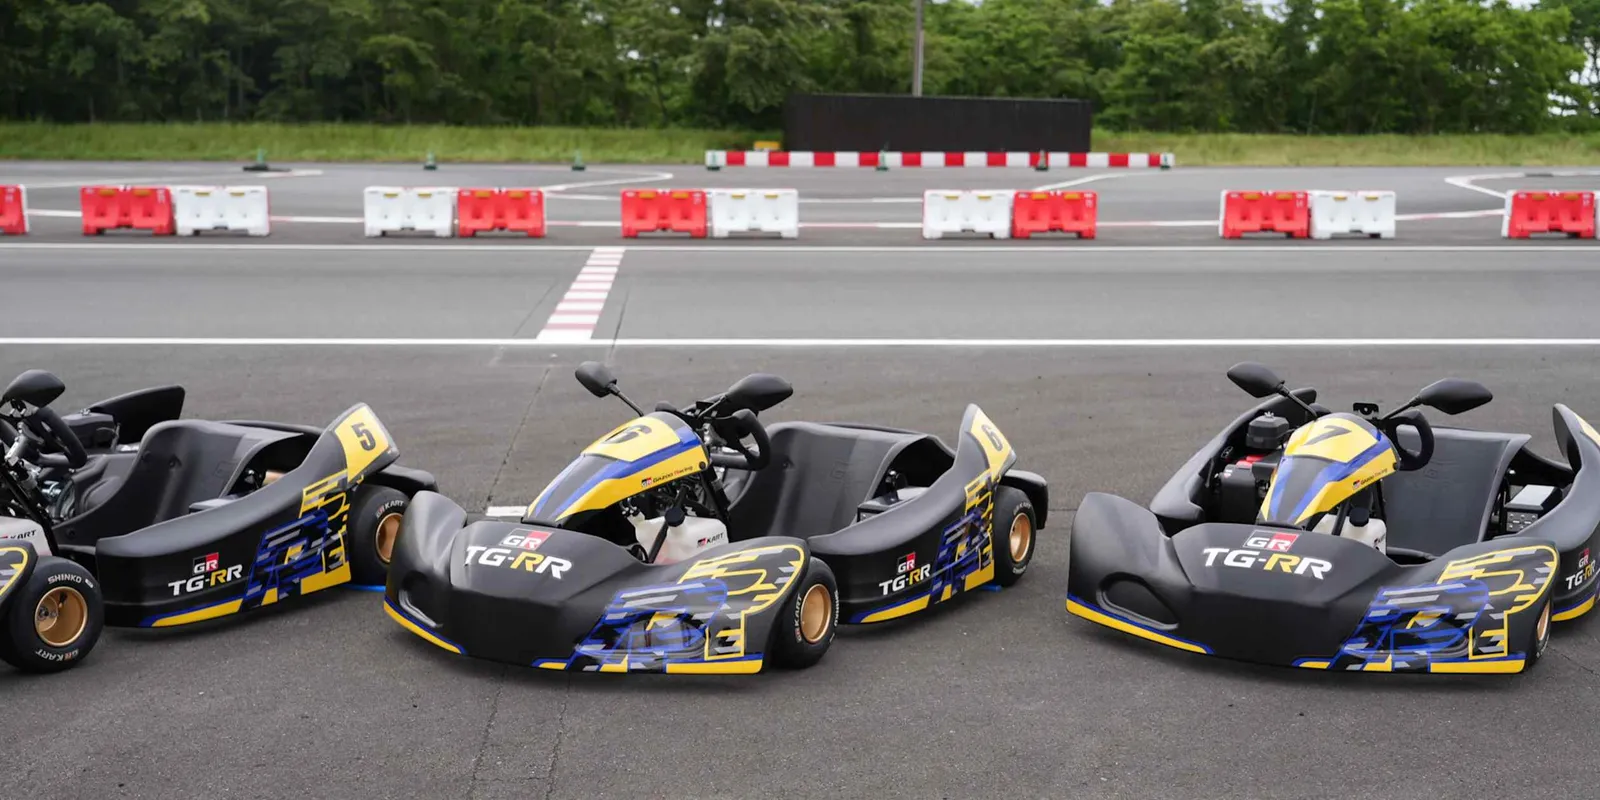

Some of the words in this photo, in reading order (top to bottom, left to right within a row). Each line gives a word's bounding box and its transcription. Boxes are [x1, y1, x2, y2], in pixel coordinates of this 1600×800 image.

[351, 422, 376, 451] 5
[600, 424, 652, 444] 6
[981, 424, 1003, 451] 6
[1302, 425, 1352, 446] 7
[501, 534, 542, 549] GR
[1245, 536, 1292, 550] GR
[193, 559, 218, 574] GR
[463, 545, 573, 580] TG-RR
[897, 559, 916, 573] GR
[1203, 547, 1332, 580] TG-RR
[47, 573, 82, 584] SHINKO
[168, 563, 243, 596] TG-RR
[878, 563, 931, 596] TG-RR
